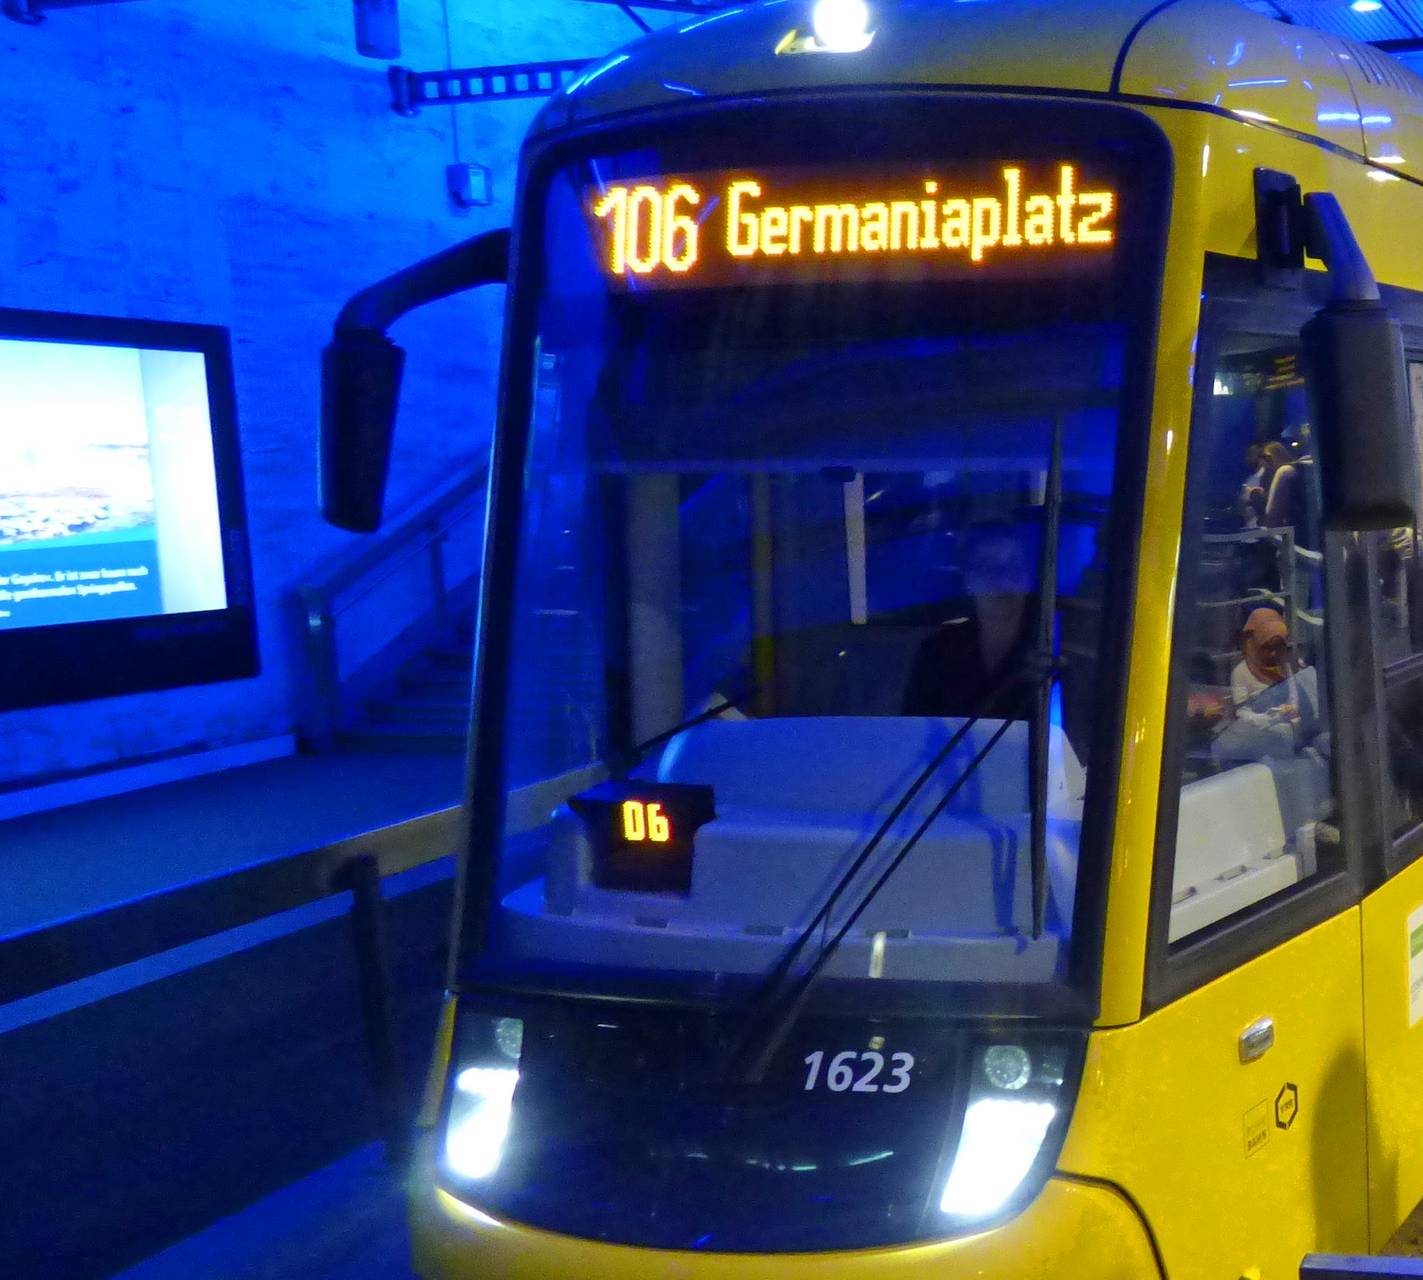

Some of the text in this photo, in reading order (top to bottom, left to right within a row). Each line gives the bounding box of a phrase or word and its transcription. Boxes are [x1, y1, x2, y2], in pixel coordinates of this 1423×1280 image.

[595, 164, 1114, 274] 106 Germaniaplatz
[803, 1050, 915, 1093] 1623
